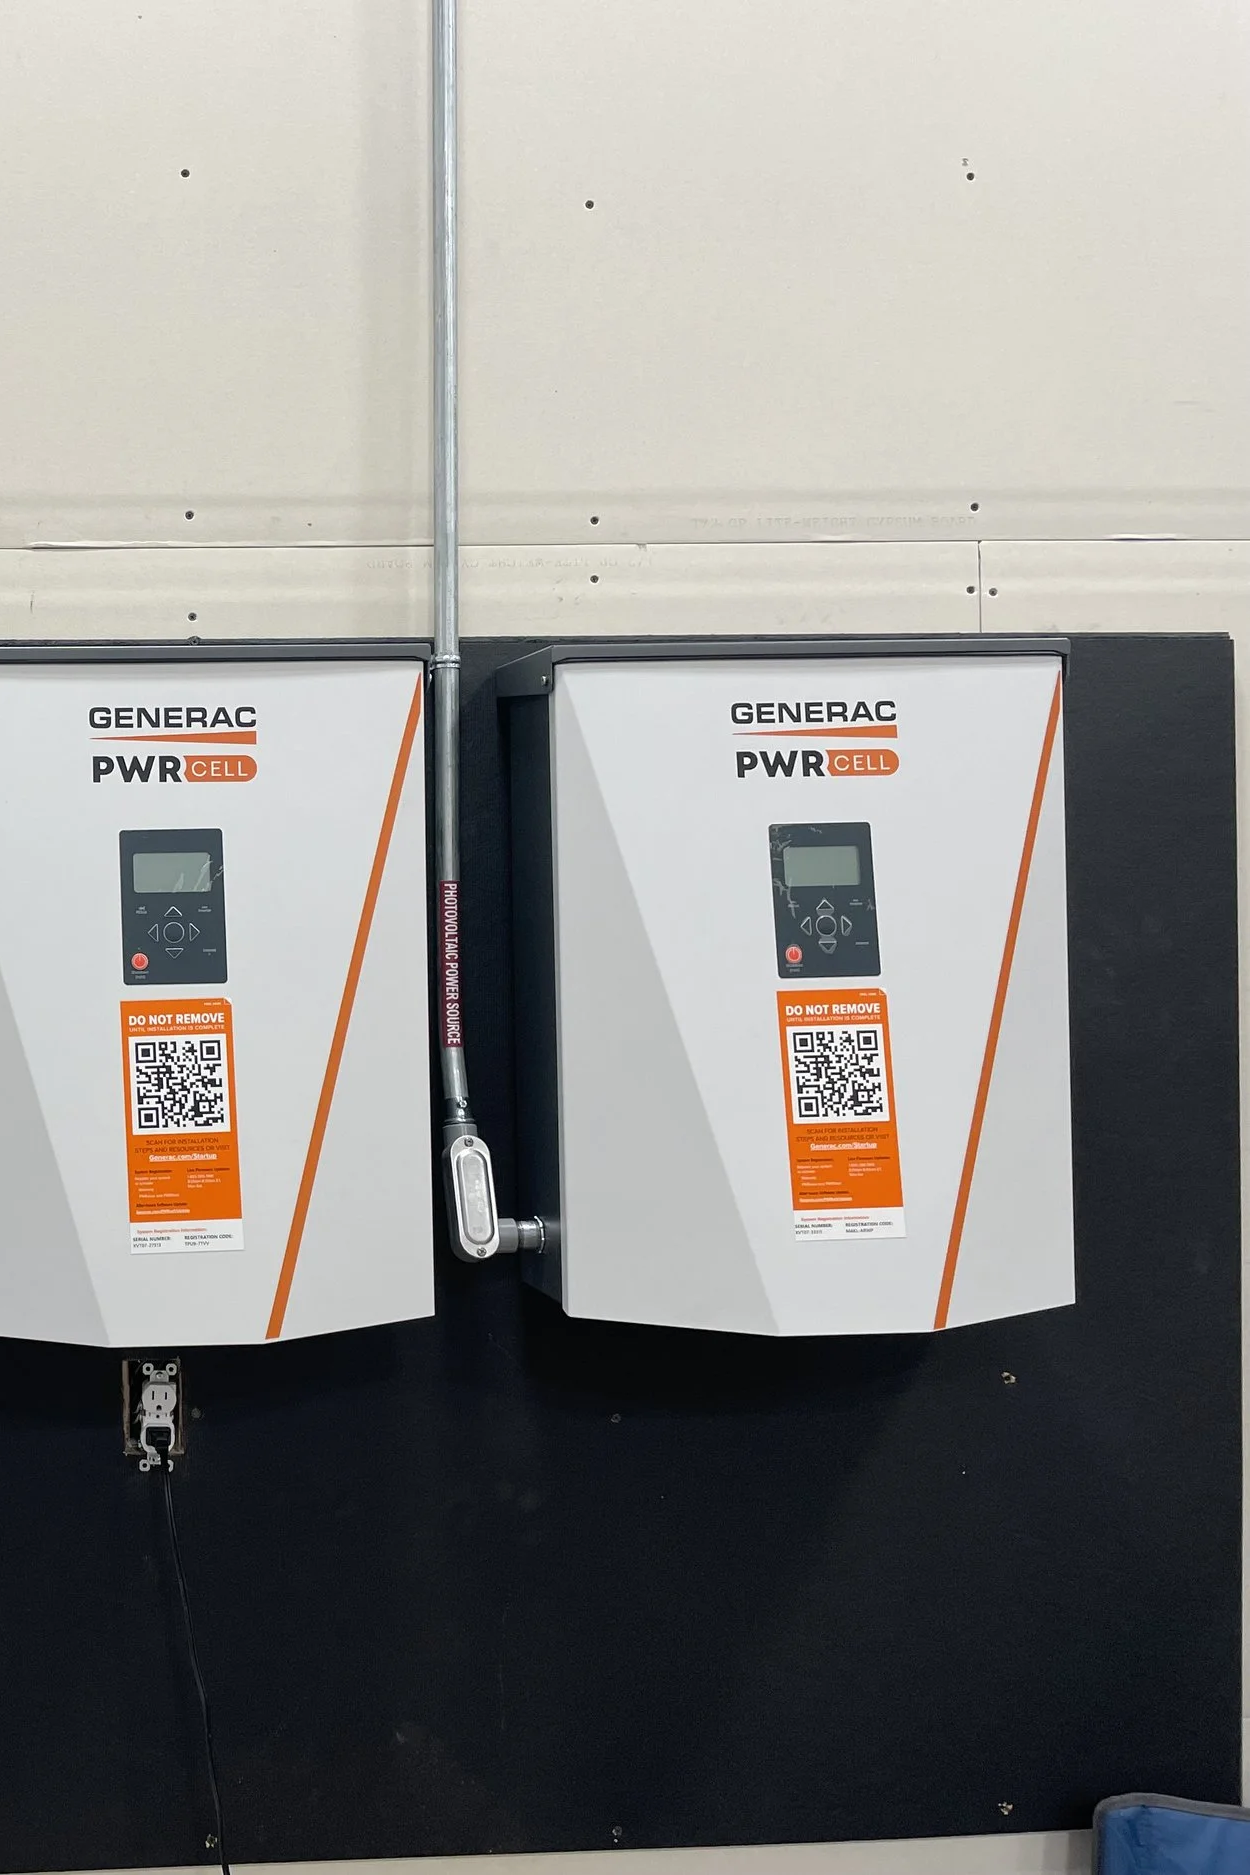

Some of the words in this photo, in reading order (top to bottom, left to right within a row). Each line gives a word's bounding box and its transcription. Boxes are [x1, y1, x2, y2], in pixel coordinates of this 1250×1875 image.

[89, 706, 256, 729] GENERAC
[731, 700, 897, 724] GENERAC
[444, 883, 459, 960] PHOTOVOLTAIC
[445, 962, 459, 1001] POWER
[128, 1015, 146, 1026] DO
[149, 1014, 173, 1025] NOT
[176, 1013, 225, 1025] REMOVE
[786, 1005, 803, 1016] DO
[806, 1005, 830, 1015] NOT
[832, 1003, 881, 1015] REMOVE
[446, 1002, 461, 1045] SOURCE
[177, 1137, 219, 1145] INSTALLATION
[149, 1153, 218, 1163] Generac.com/Startup
